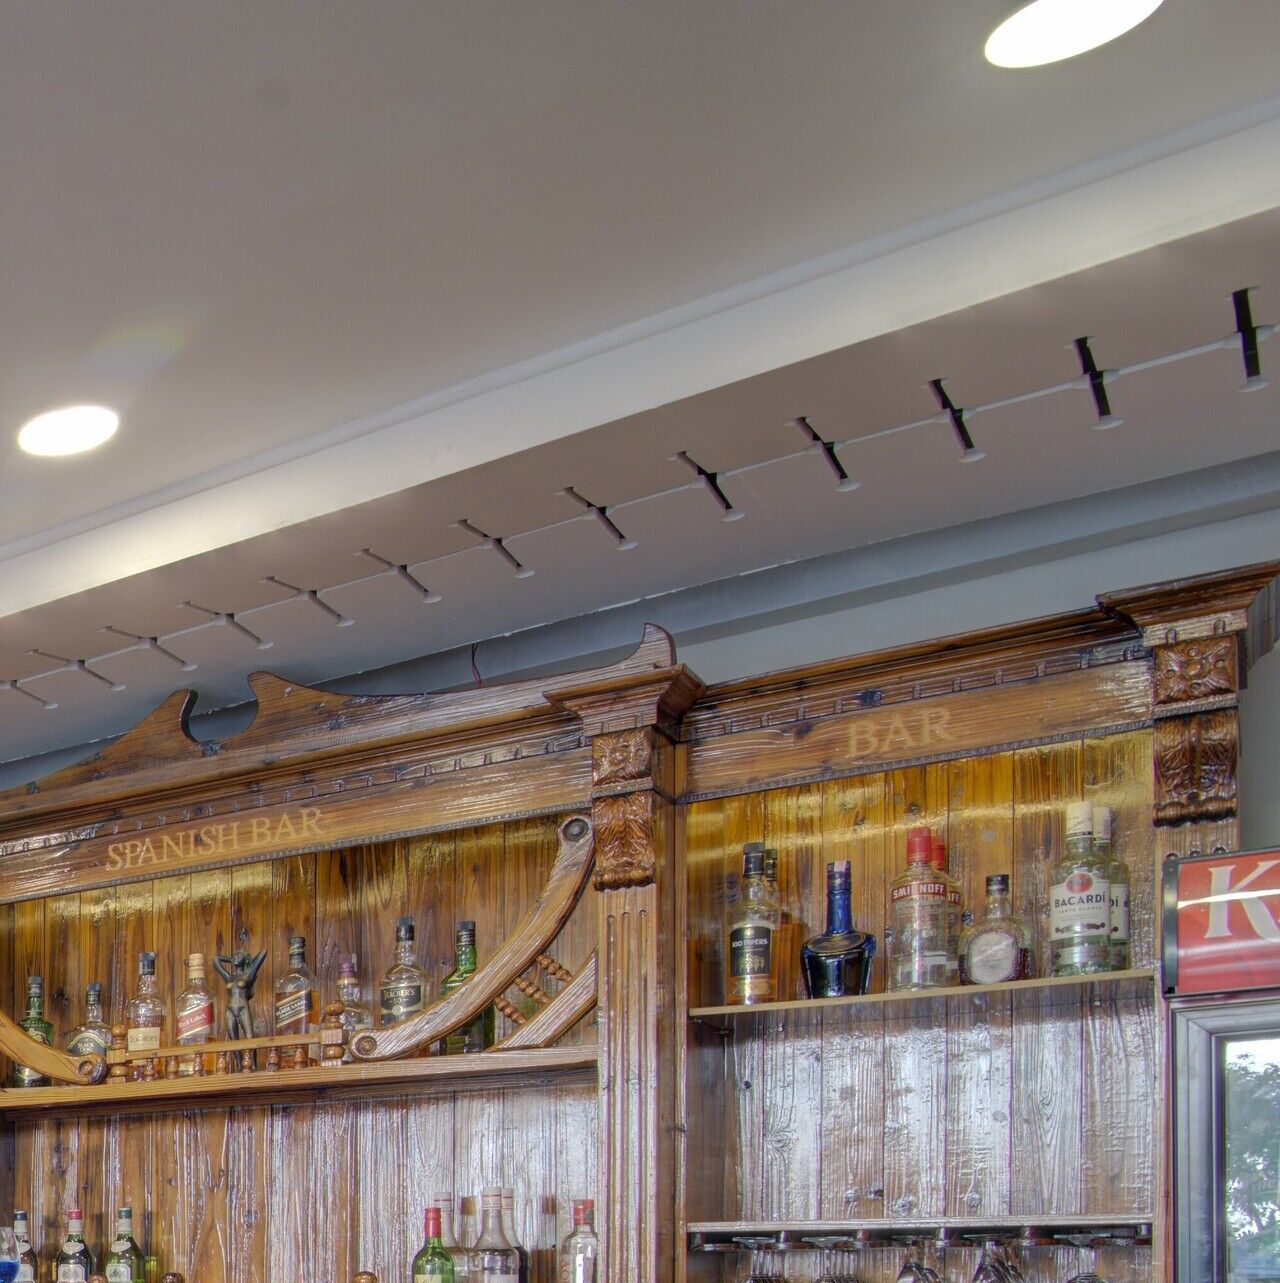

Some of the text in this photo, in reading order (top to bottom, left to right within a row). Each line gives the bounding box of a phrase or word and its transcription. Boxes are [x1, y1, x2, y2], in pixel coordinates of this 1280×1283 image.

[844, 706, 956, 758] BAR
[105, 807, 325, 872] SPANISH BAR
[893, 883, 945, 900] SMINOFF
[1054, 891, 1106, 908] BACARDÍ
